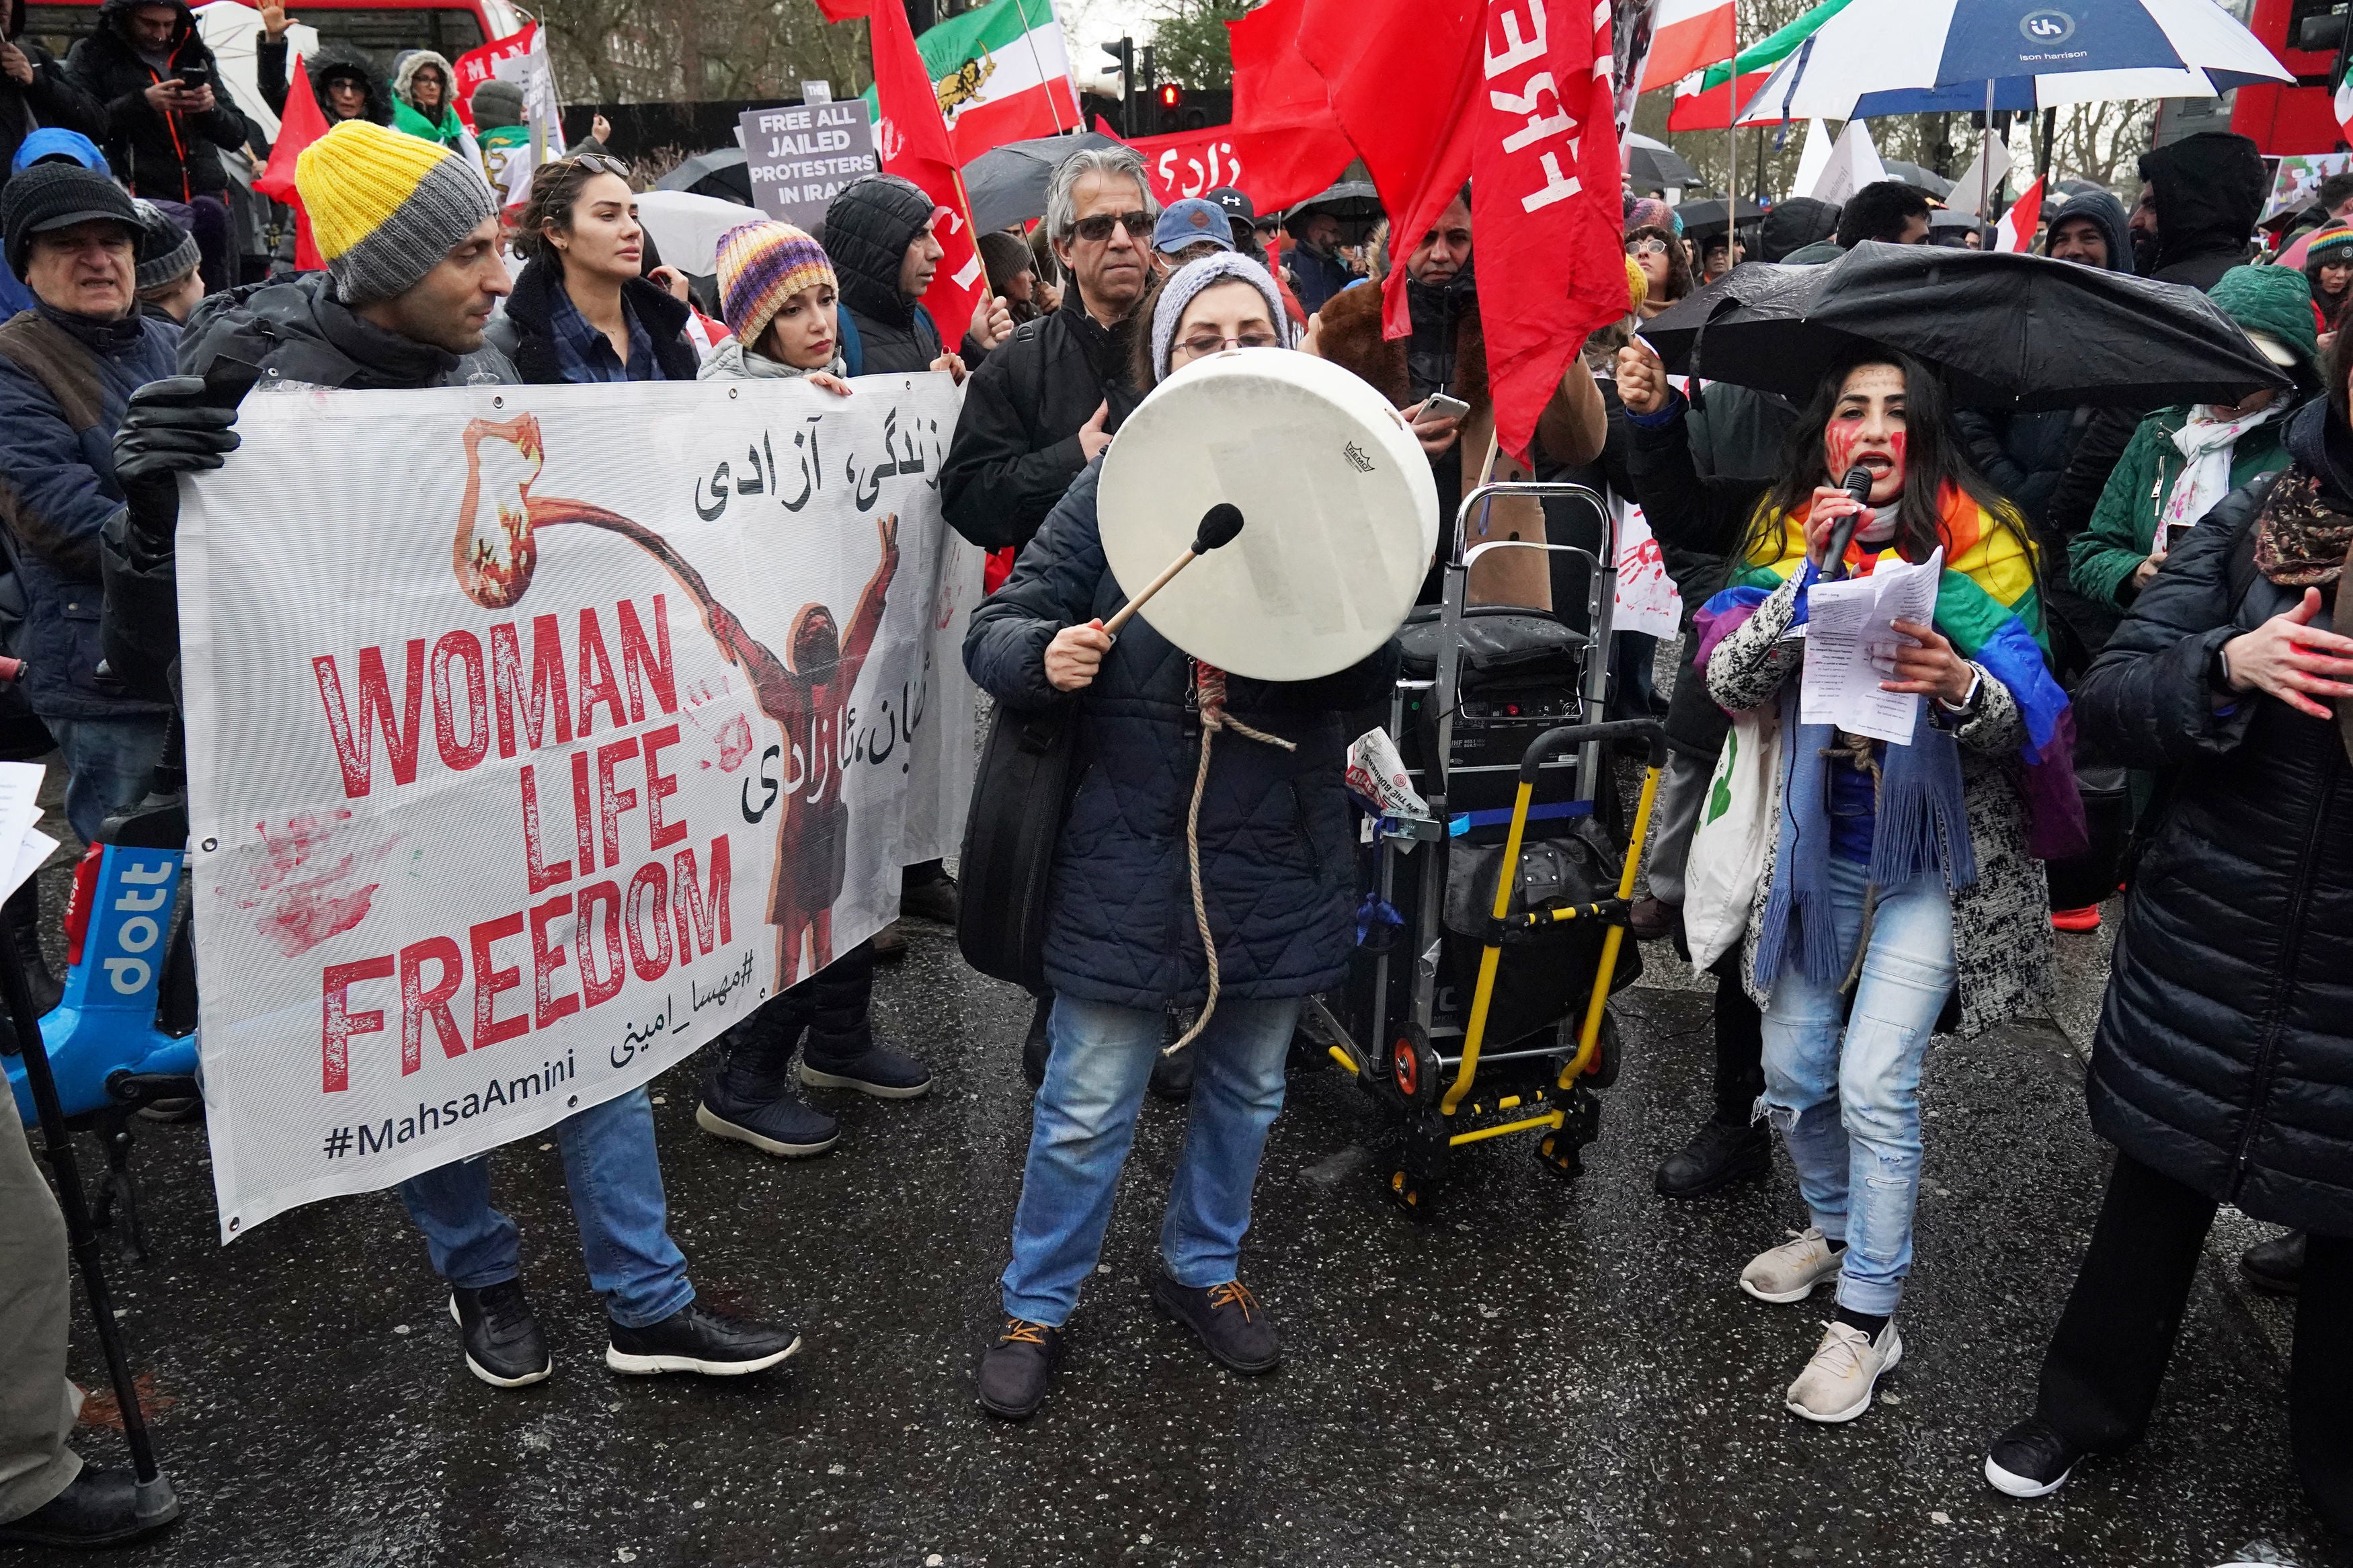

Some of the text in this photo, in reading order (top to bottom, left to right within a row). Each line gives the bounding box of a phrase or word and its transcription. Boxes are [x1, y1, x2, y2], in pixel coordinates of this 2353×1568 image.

[2044, 50, 2087, 60] harrison
[759, 108, 856, 133] FREE ALL
[768, 130, 850, 158] JAILED
[750, 155, 875, 183] PROTESTERS
[779, 186, 800, 204] IN
[1860, 369, 1894, 378] STOP
[695, 414, 822, 522] آزادی
[1348, 447, 1368, 469] REMO
[312, 593, 679, 798] WOMAN
[1360, 752, 1392, 792] BORDERS!
[520, 724, 688, 895] LIFE
[1390, 790, 1407, 804] THE
[67, 877, 79, 916] dott
[104, 862, 173, 995] dott
[322, 833, 732, 1094] FREEDOM
[324, 1048, 575, 1160] #MahsaAmini
